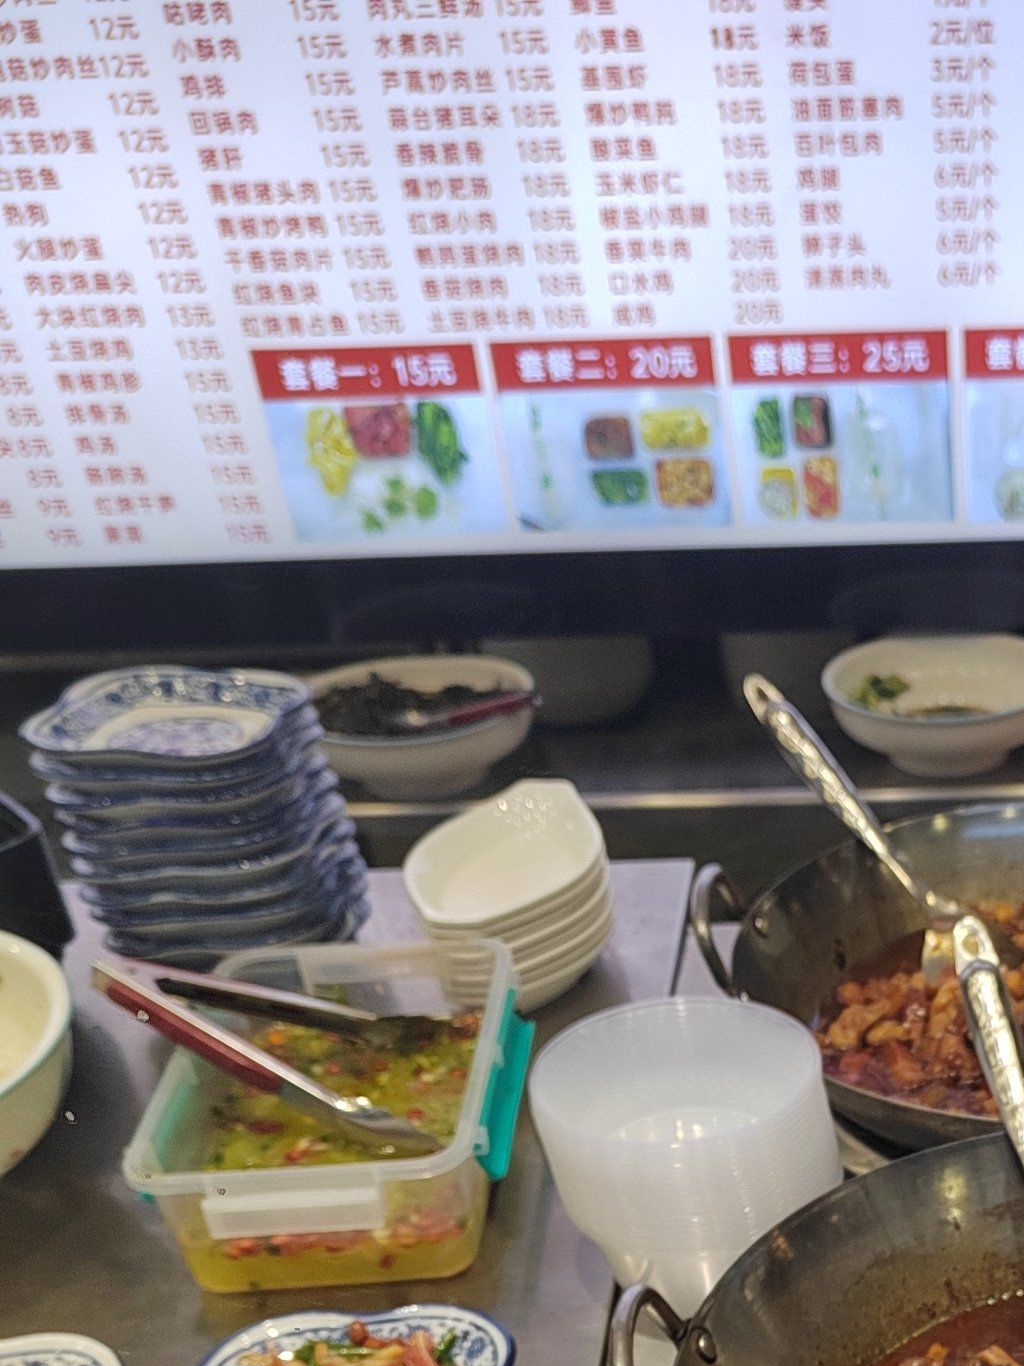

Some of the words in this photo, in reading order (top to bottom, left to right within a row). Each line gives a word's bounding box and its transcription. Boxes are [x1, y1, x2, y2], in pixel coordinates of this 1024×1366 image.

[289, 0, 341, 21] 15元
[497, 0, 543, 16] 15元
[88, 16, 140, 40] 12元
[575, 28, 645, 54] 小黄鱼
[710, 25, 759, 50] 18元
[785, 23, 829, 48] 米饭
[297, 34, 349, 59] 15元
[373, 32, 463, 57] 水煮肉片
[499, 30, 550, 54] 15元
[101, 54, 150, 78] 12元
[714, 62, 763, 87] 18元
[787, 59, 854, 86] 荷包蛋
[930, 54, 996, 83] 3元/个
[305, 72, 355, 95] 15元
[506, 67, 556, 91] 15元
[108, 91, 160, 116] 12元
[511, 102, 561, 128] 18元
[718, 98, 766, 124] 18元
[189, 111, 259, 135] 回锅肉
[313, 107, 364, 132] 15元
[118, 128, 169, 152] 12元
[518, 139, 566, 163] 18元
[590, 136, 657, 161] 酸菜鱼
[721, 134, 770, 158] 18元
[321, 144, 371, 167] 15元
[128, 164, 179, 189] 12元
[523, 174, 571, 197] 18元
[725, 168, 773, 193] 18元
[328, 178, 378, 202] 15元
[138, 201, 188, 225] 12元
[335, 212, 385, 236] 15元
[528, 208, 576, 231] 18元
[728, 202, 775, 227] 18元
[14, 237, 104, 261] 火腿炒蛋
[148, 234, 198, 259] 12元
[343, 246, 392, 270] 15元
[534, 242, 581, 265] 18元
[727, 235, 779, 261] 20元
[158, 271, 207, 294] 12元
[350, 280, 398, 302] 15元
[539, 275, 586, 297] 18元
[731, 268, 781, 293] 20元
[167, 305, 215, 327] 13元
[357, 312, 405, 335] 15元
[544, 306, 590, 329] 18元
[734, 300, 784, 325] 20元
[176, 338, 224, 360] 13元
[185, 370, 233, 392] 15元
[193, 402, 242, 423] 15元
[202, 434, 249, 454] 15元
[211, 464, 257, 484] 15元
